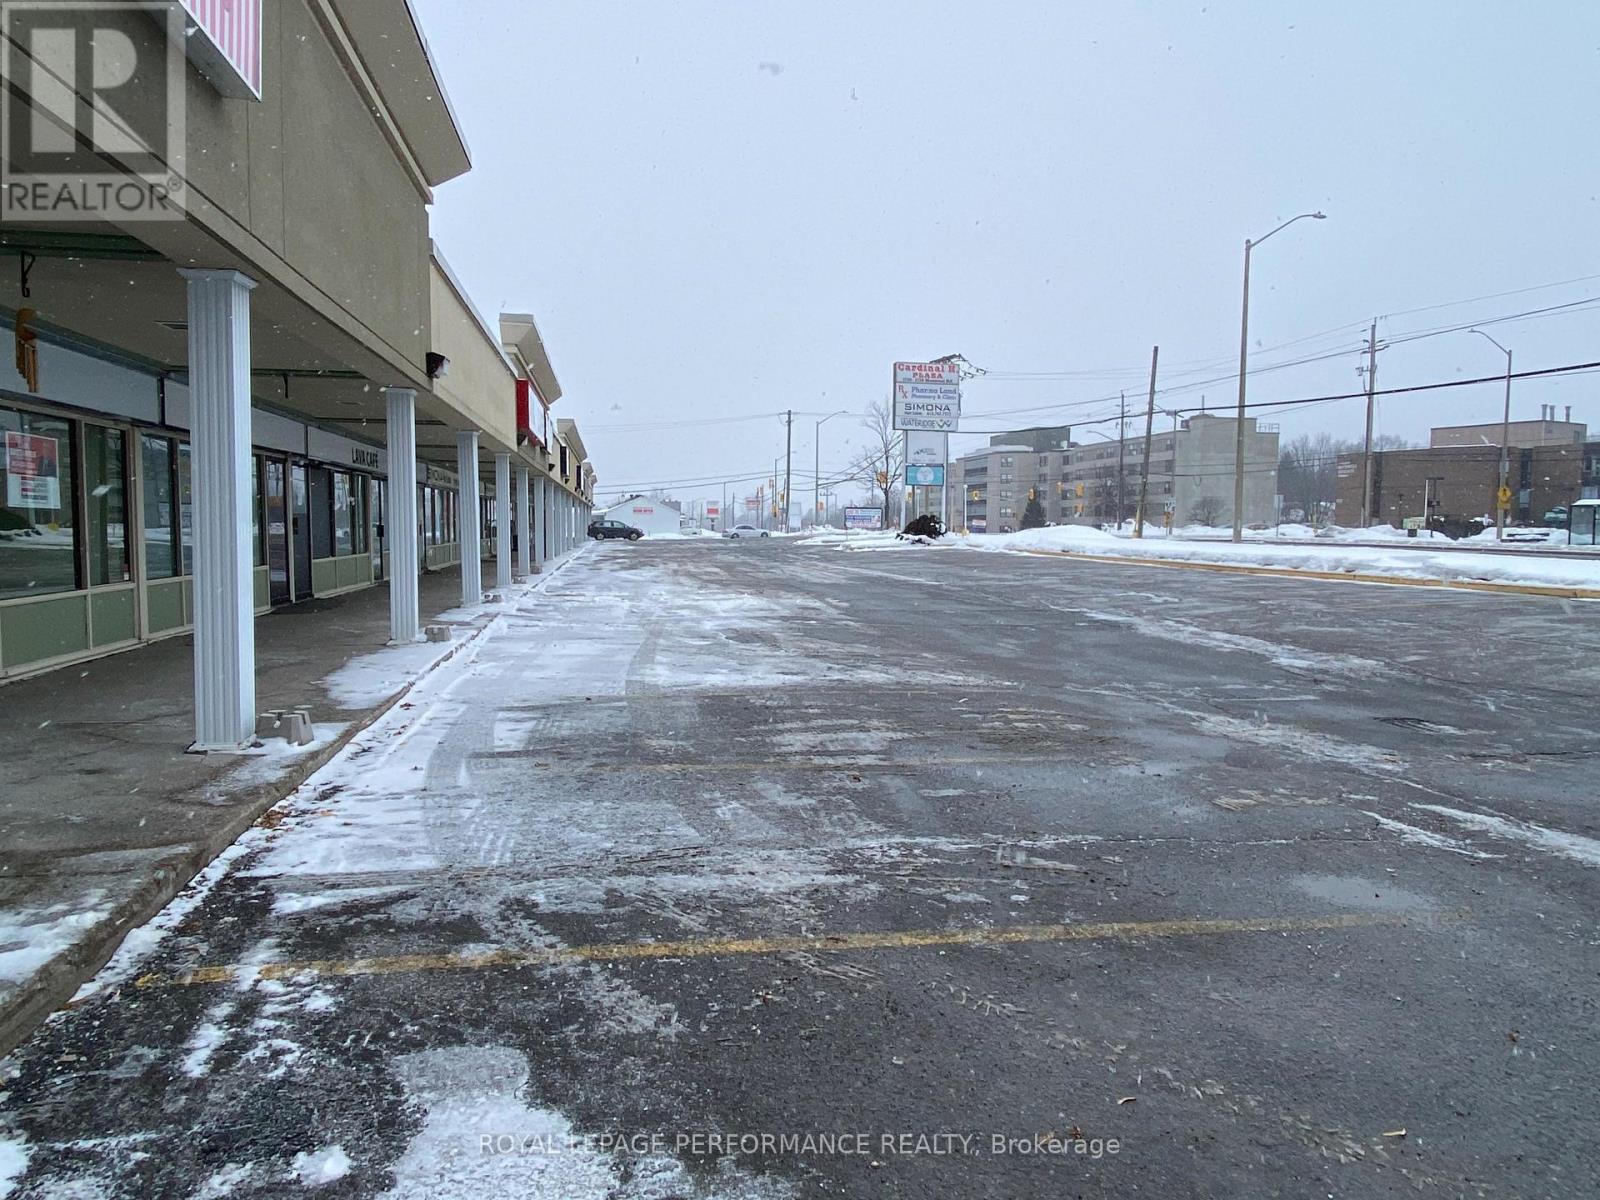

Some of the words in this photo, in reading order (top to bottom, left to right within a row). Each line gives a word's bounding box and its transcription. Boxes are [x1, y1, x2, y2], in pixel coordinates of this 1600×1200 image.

[897, 363, 944, 373] Cardinal
[912, 372, 943, 380] PLAZA
[904, 403, 951, 412] SIMONA
[351, 447, 366, 466] LAVA
